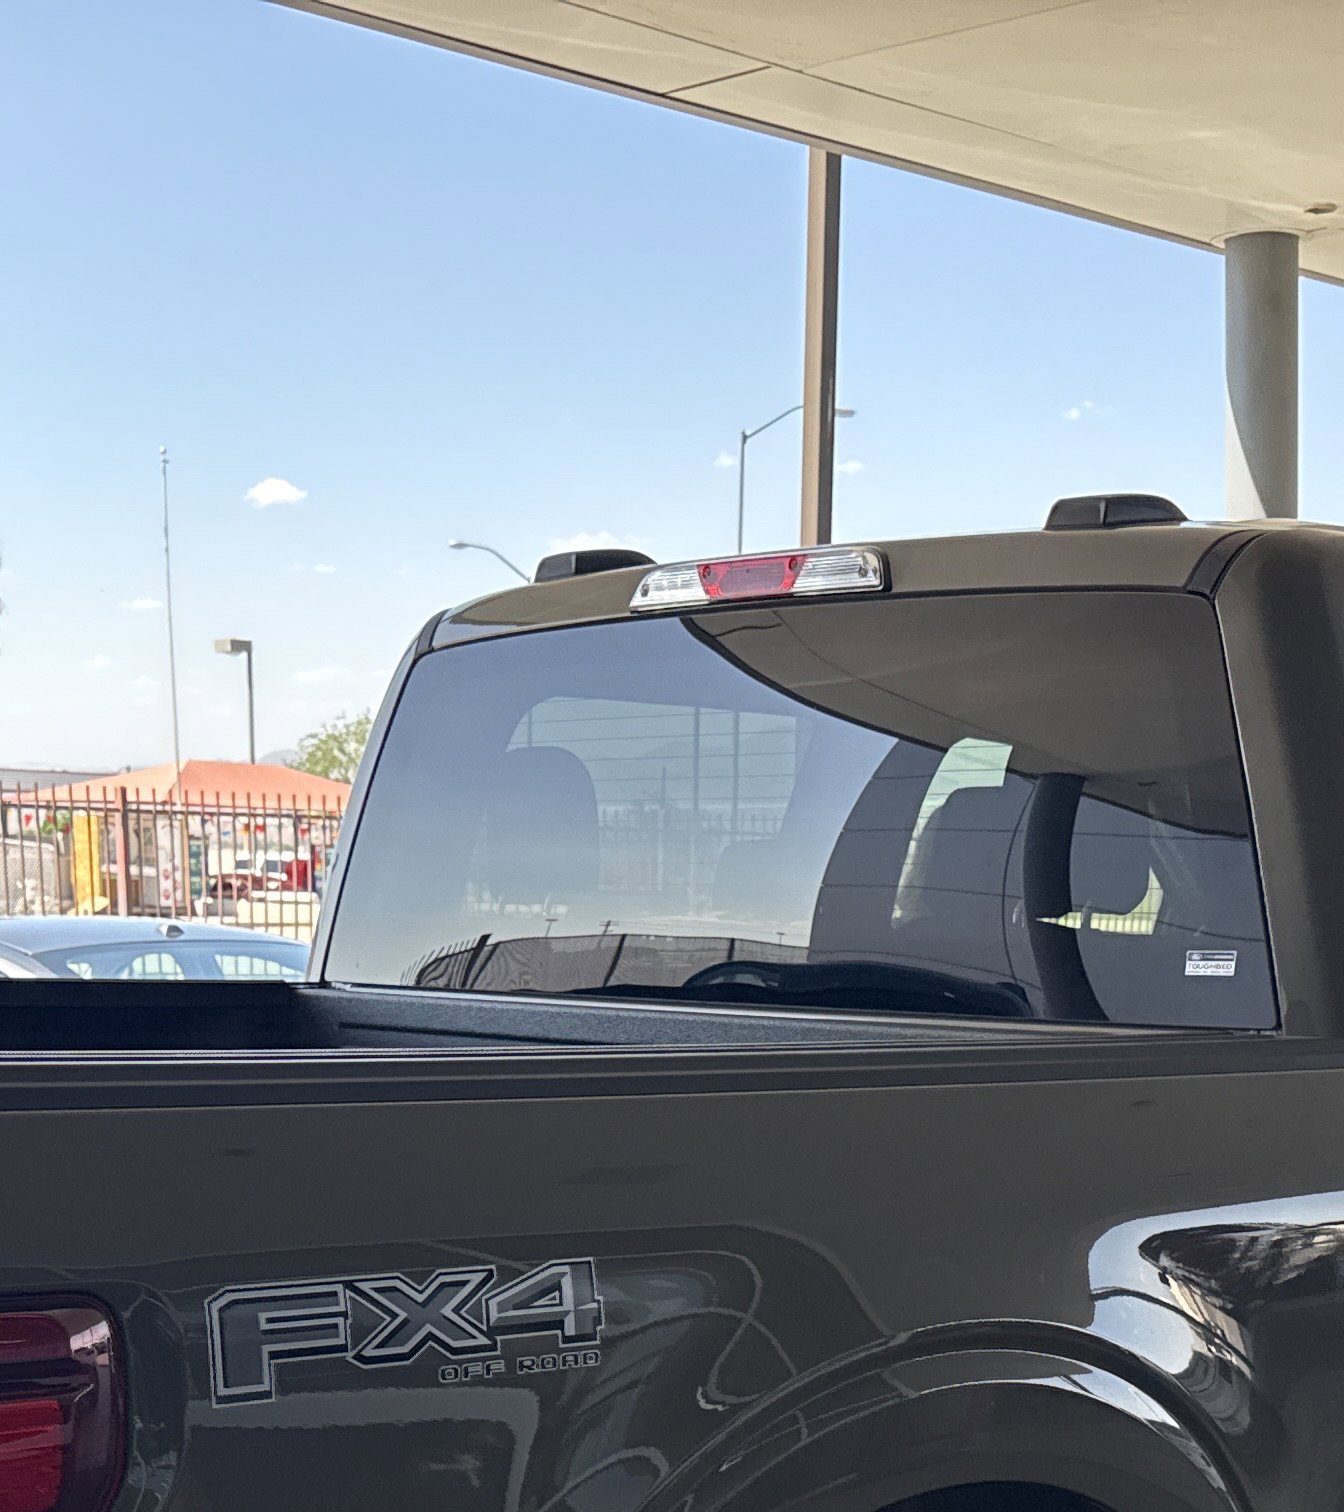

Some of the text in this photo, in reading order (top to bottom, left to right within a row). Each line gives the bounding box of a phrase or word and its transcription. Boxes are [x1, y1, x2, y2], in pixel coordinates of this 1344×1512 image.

[203, 1257, 605, 1409] FX4
[438, 1350, 602, 1384] OFF ROAD
